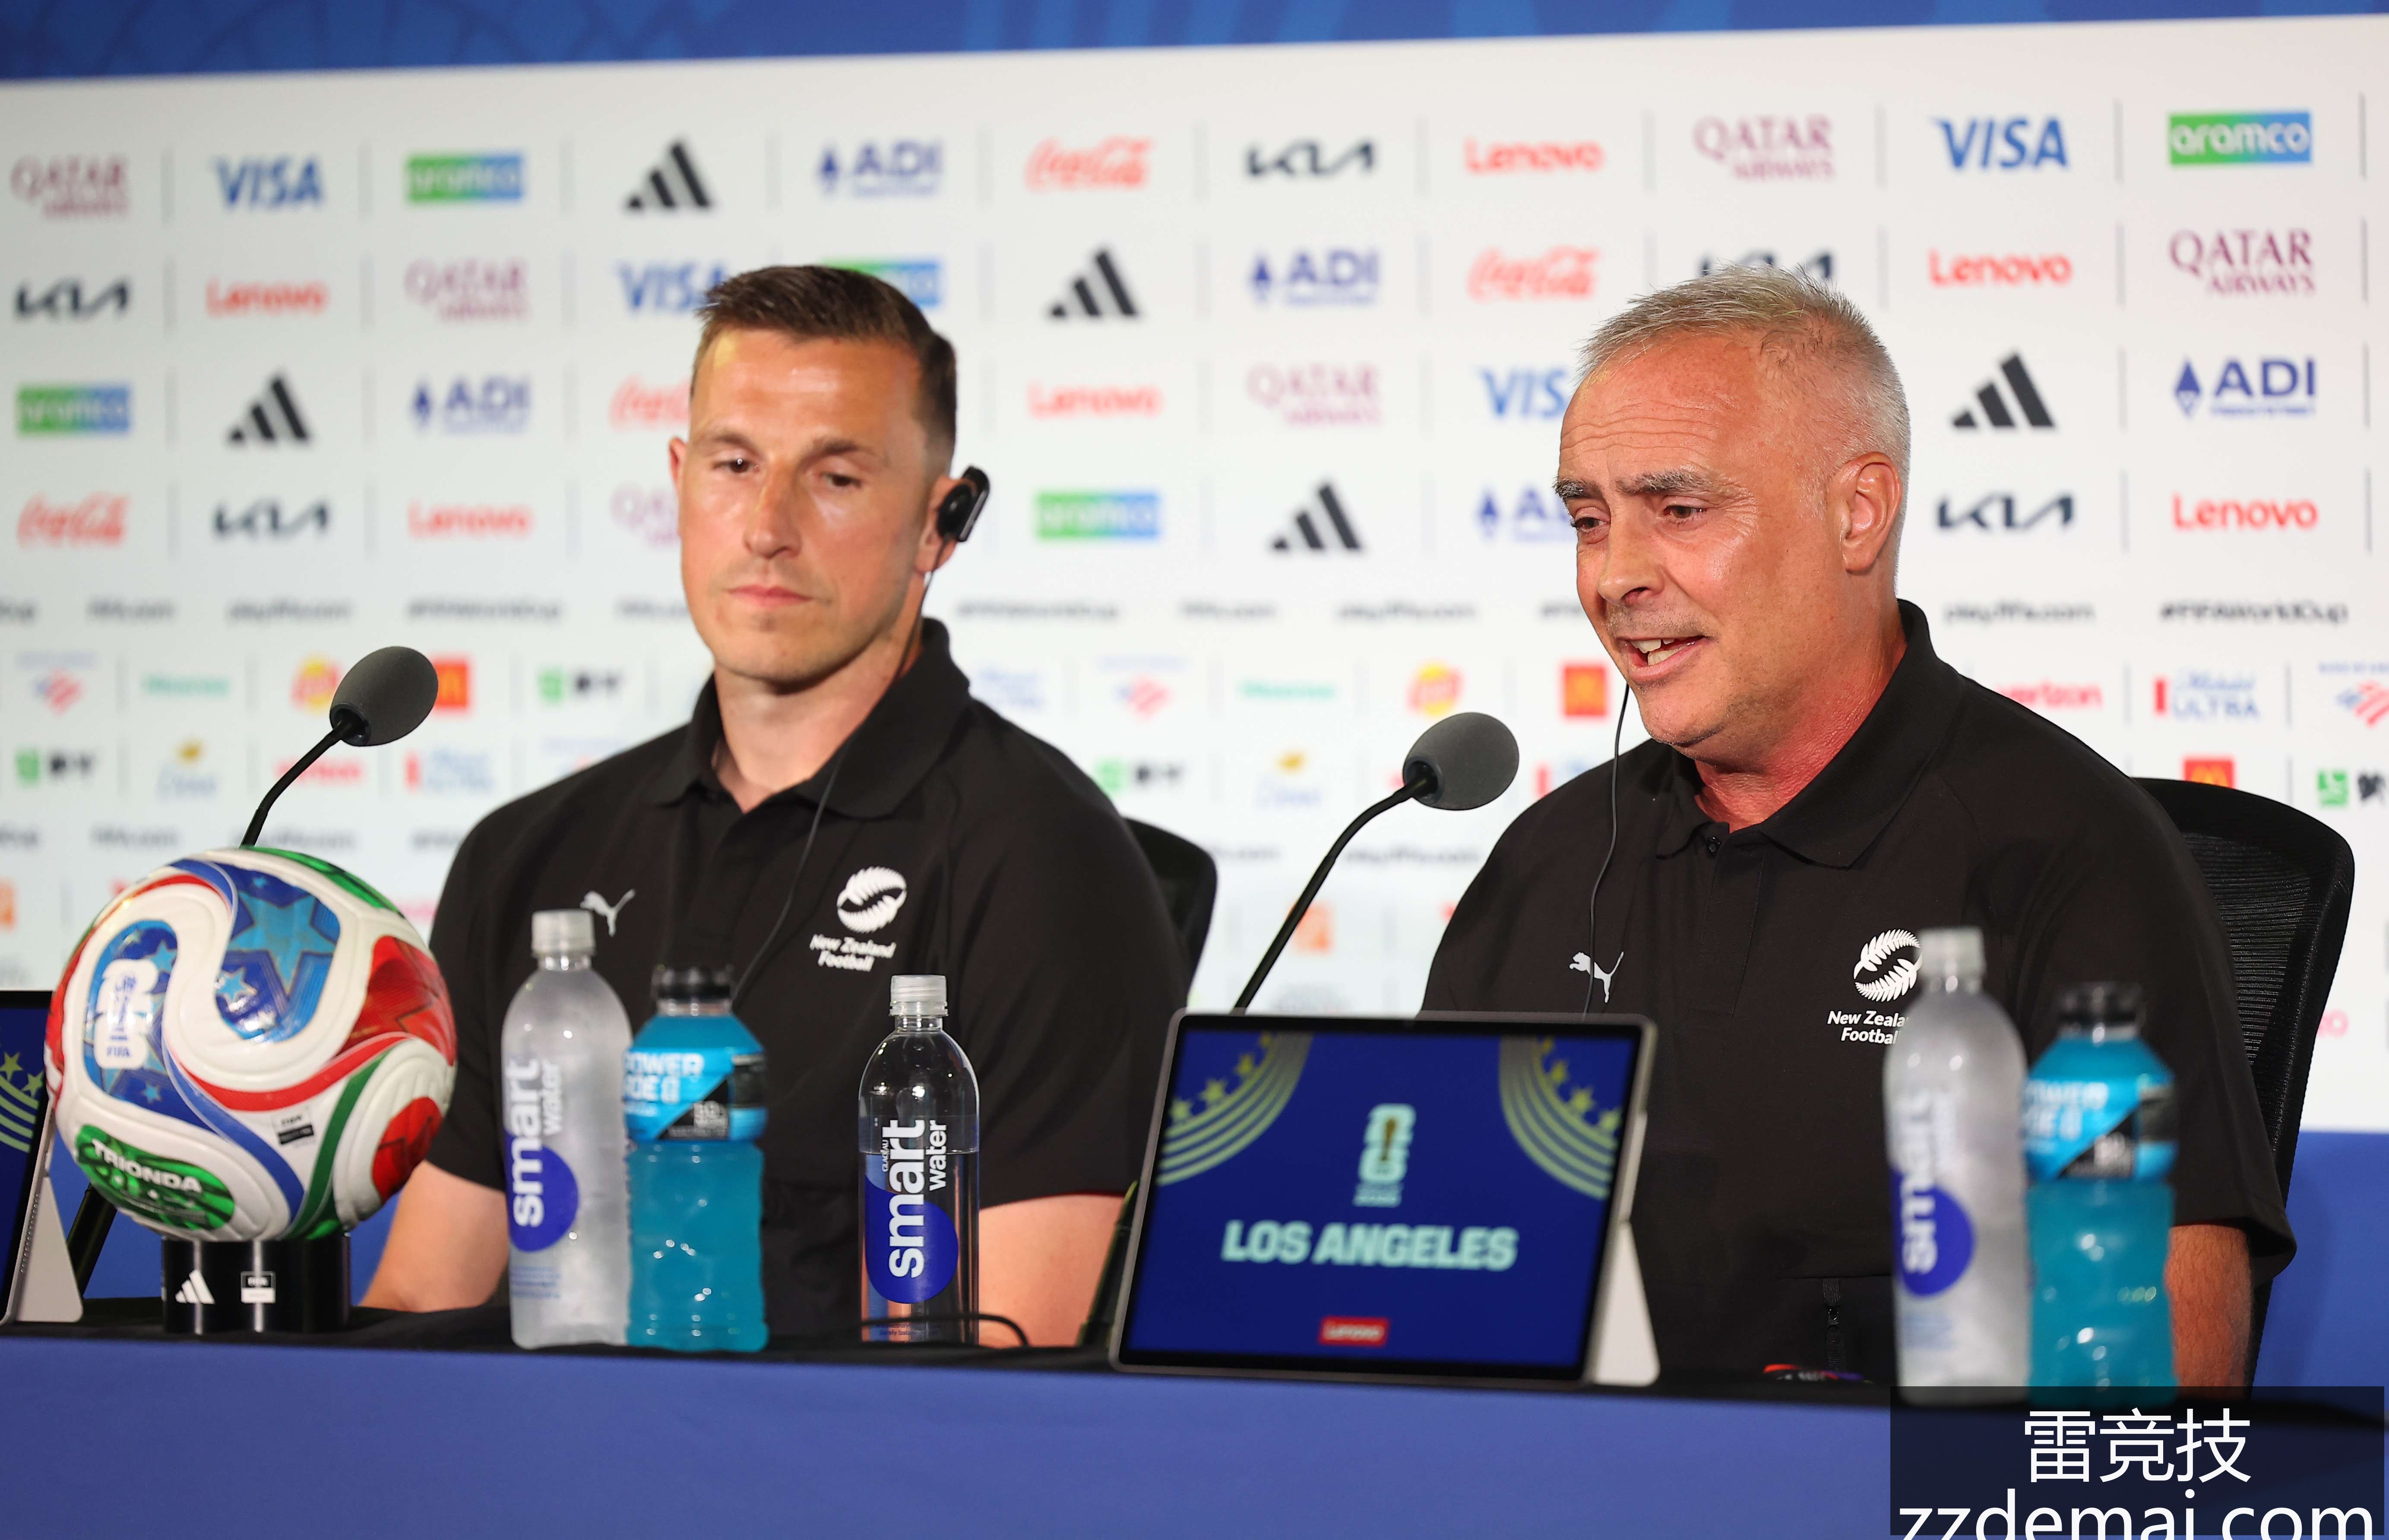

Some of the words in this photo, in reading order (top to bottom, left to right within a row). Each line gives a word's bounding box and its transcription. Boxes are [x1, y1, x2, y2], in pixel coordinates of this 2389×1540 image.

[1465, 140, 1603, 174] Lenovo
[1693, 115, 1832, 162] QATAR
[1933, 116, 2069, 170] VISA
[2172, 122, 2310, 155] aramco
[211, 156, 325, 209] VISA
[1286, 250, 1380, 287] ADI
[1928, 250, 2073, 287] Lenovo
[2170, 229, 2312, 278] QATAR
[2207, 271, 2316, 295] AIRWAYS
[1481, 367, 1569, 420] VIS
[2213, 358, 2316, 398] ADI
[2172, 494, 2319, 530] Lenovo
[810, 934, 841, 951] New
[840, 937, 897, 959] Zealand
[817, 951, 875, 972] Football
[1827, 1011, 1862, 1025] New
[1863, 1010, 1909, 1028] Zeala
[1841, 1027, 1902, 1045] Footbal
[505, 1059, 545, 1227] smart
[925, 1119, 947, 1192] water
[92, 1138, 203, 1193] TRIONDA
[882, 1119, 926, 1278] smart
[1221, 1219, 1313, 1265] LOS
[1311, 1222, 1520, 1272] ANGELES
